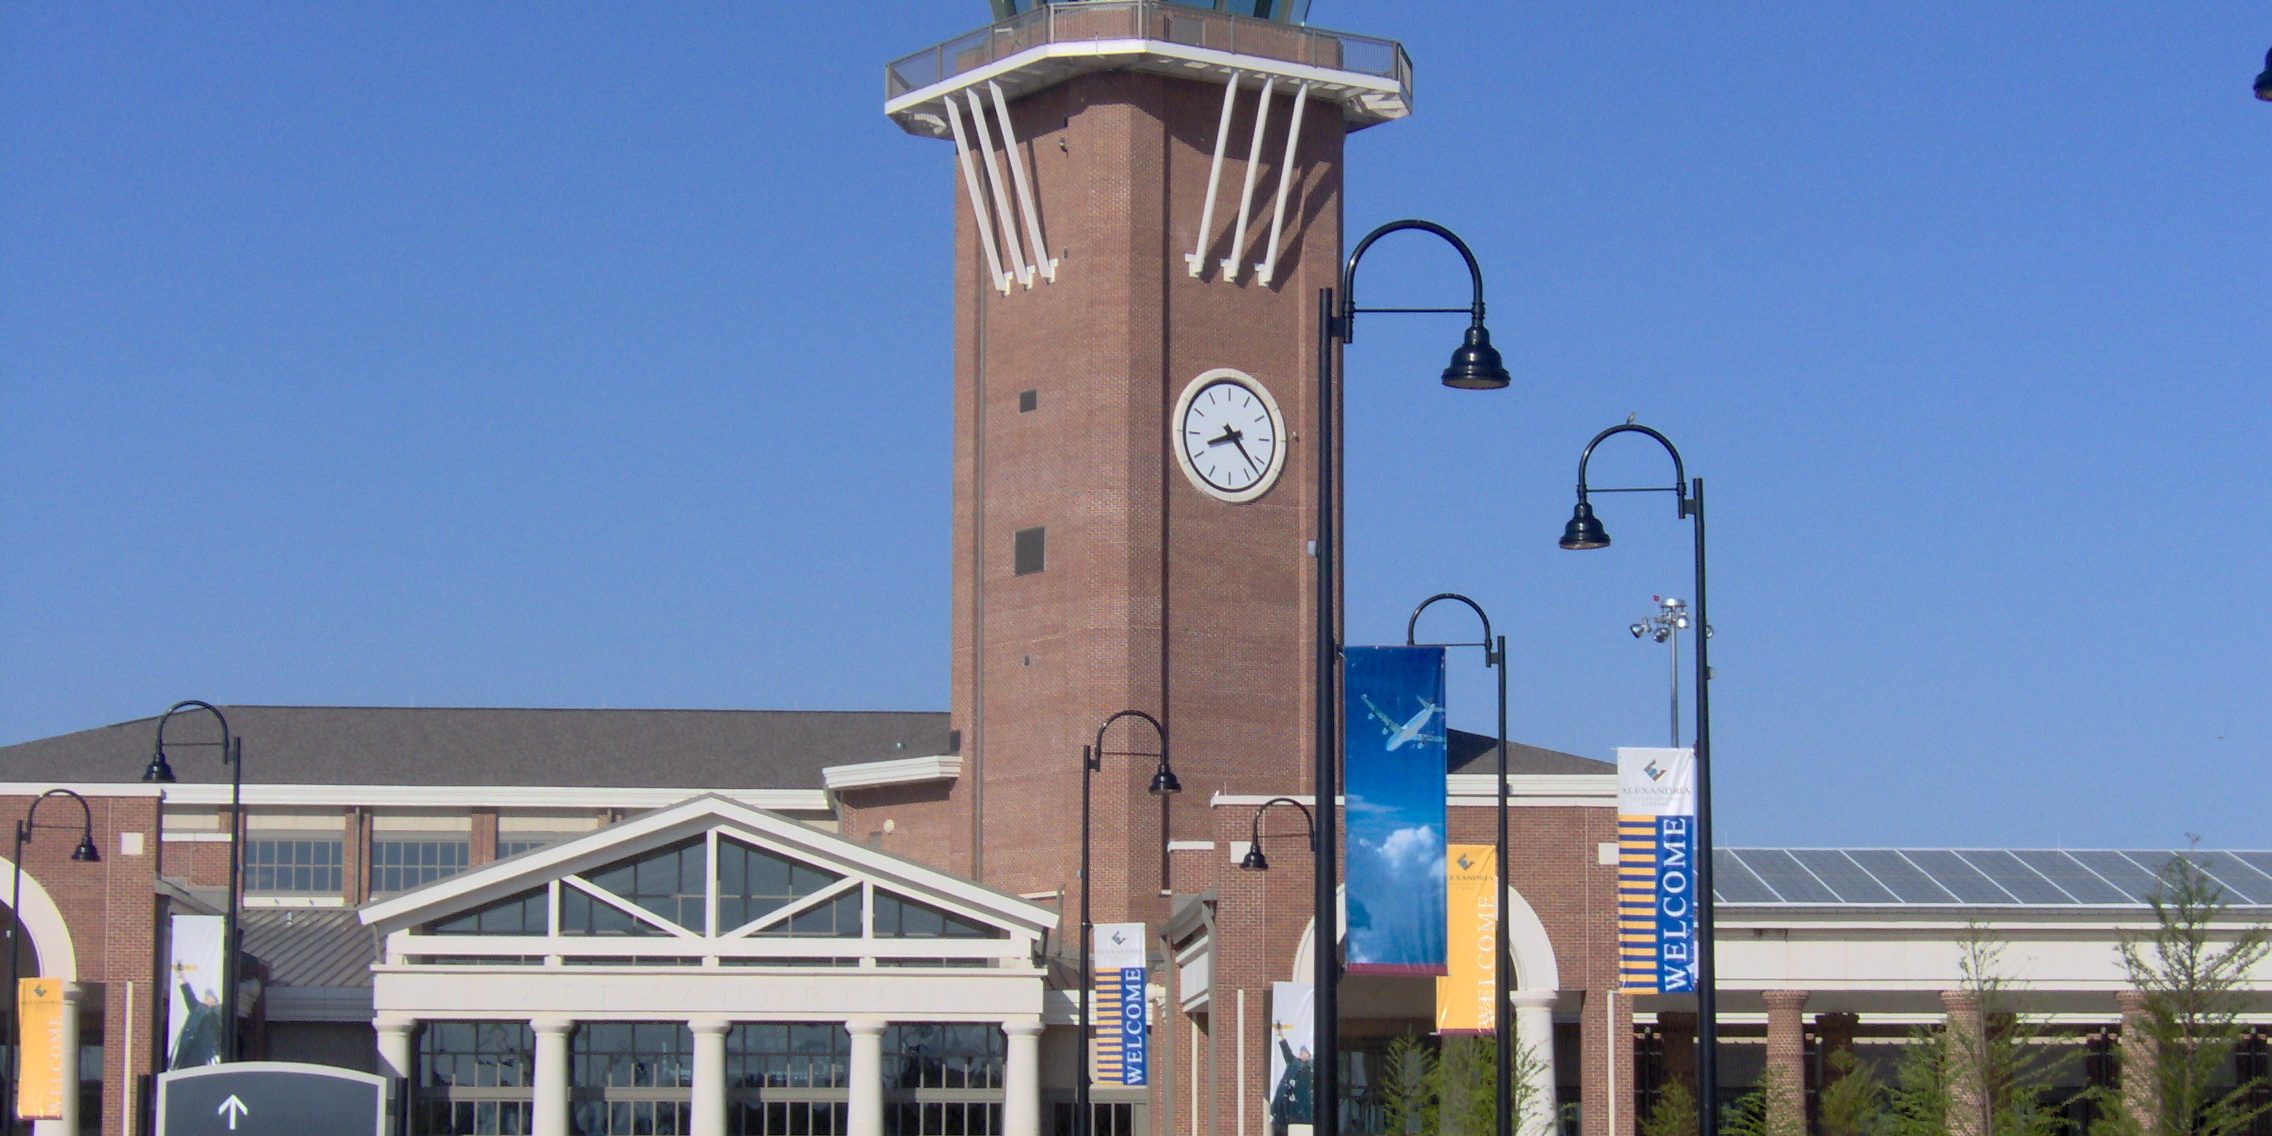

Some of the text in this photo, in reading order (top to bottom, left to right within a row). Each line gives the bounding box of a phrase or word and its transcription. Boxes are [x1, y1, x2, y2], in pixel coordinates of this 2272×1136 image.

[1622, 786, 1690, 794] ALEXANDRIA
[1478, 895, 1496, 1030] WELCOME
[1663, 818, 1688, 991] WELCOME
[1125, 969, 1144, 1085] WELCOME
